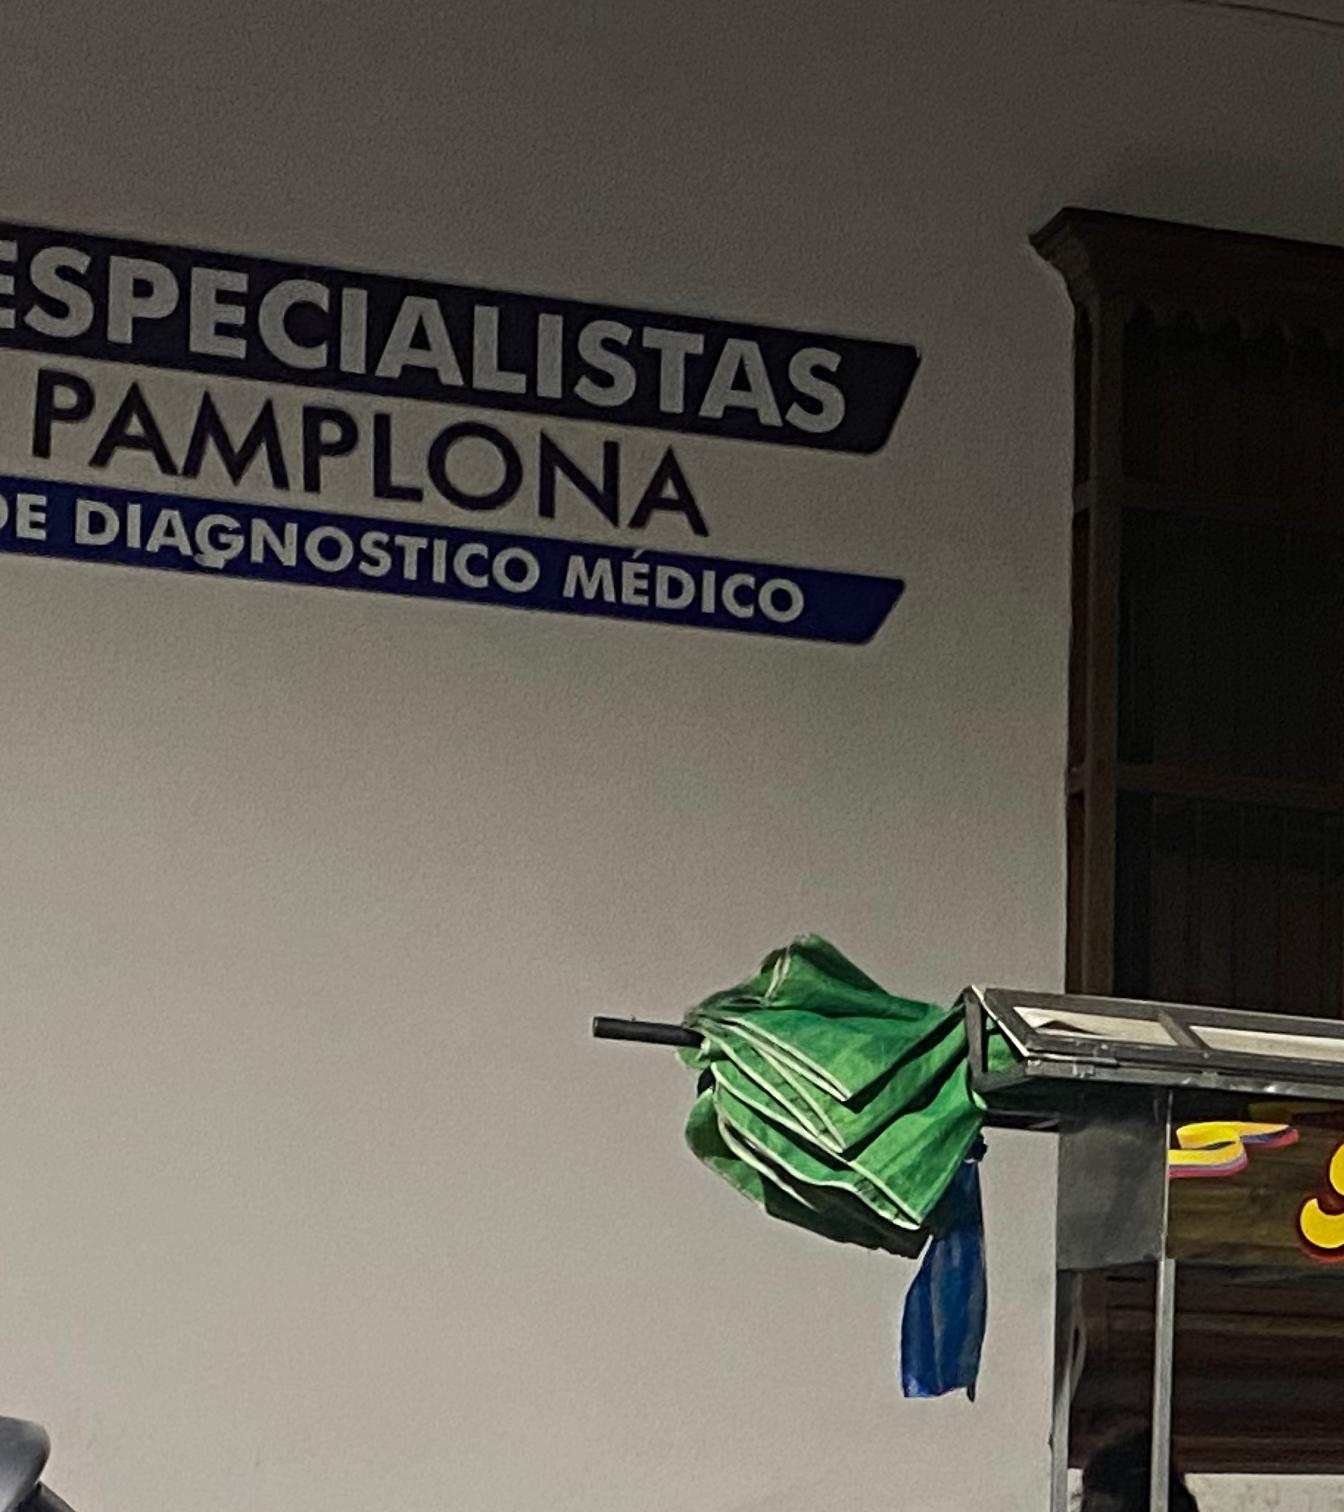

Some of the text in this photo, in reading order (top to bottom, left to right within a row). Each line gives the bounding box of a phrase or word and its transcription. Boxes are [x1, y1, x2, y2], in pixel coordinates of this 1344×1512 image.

[31, 367, 710, 538] PAMPLONA
[0, 493, 805, 624] E DIAGNOSTICO MÉDICO
